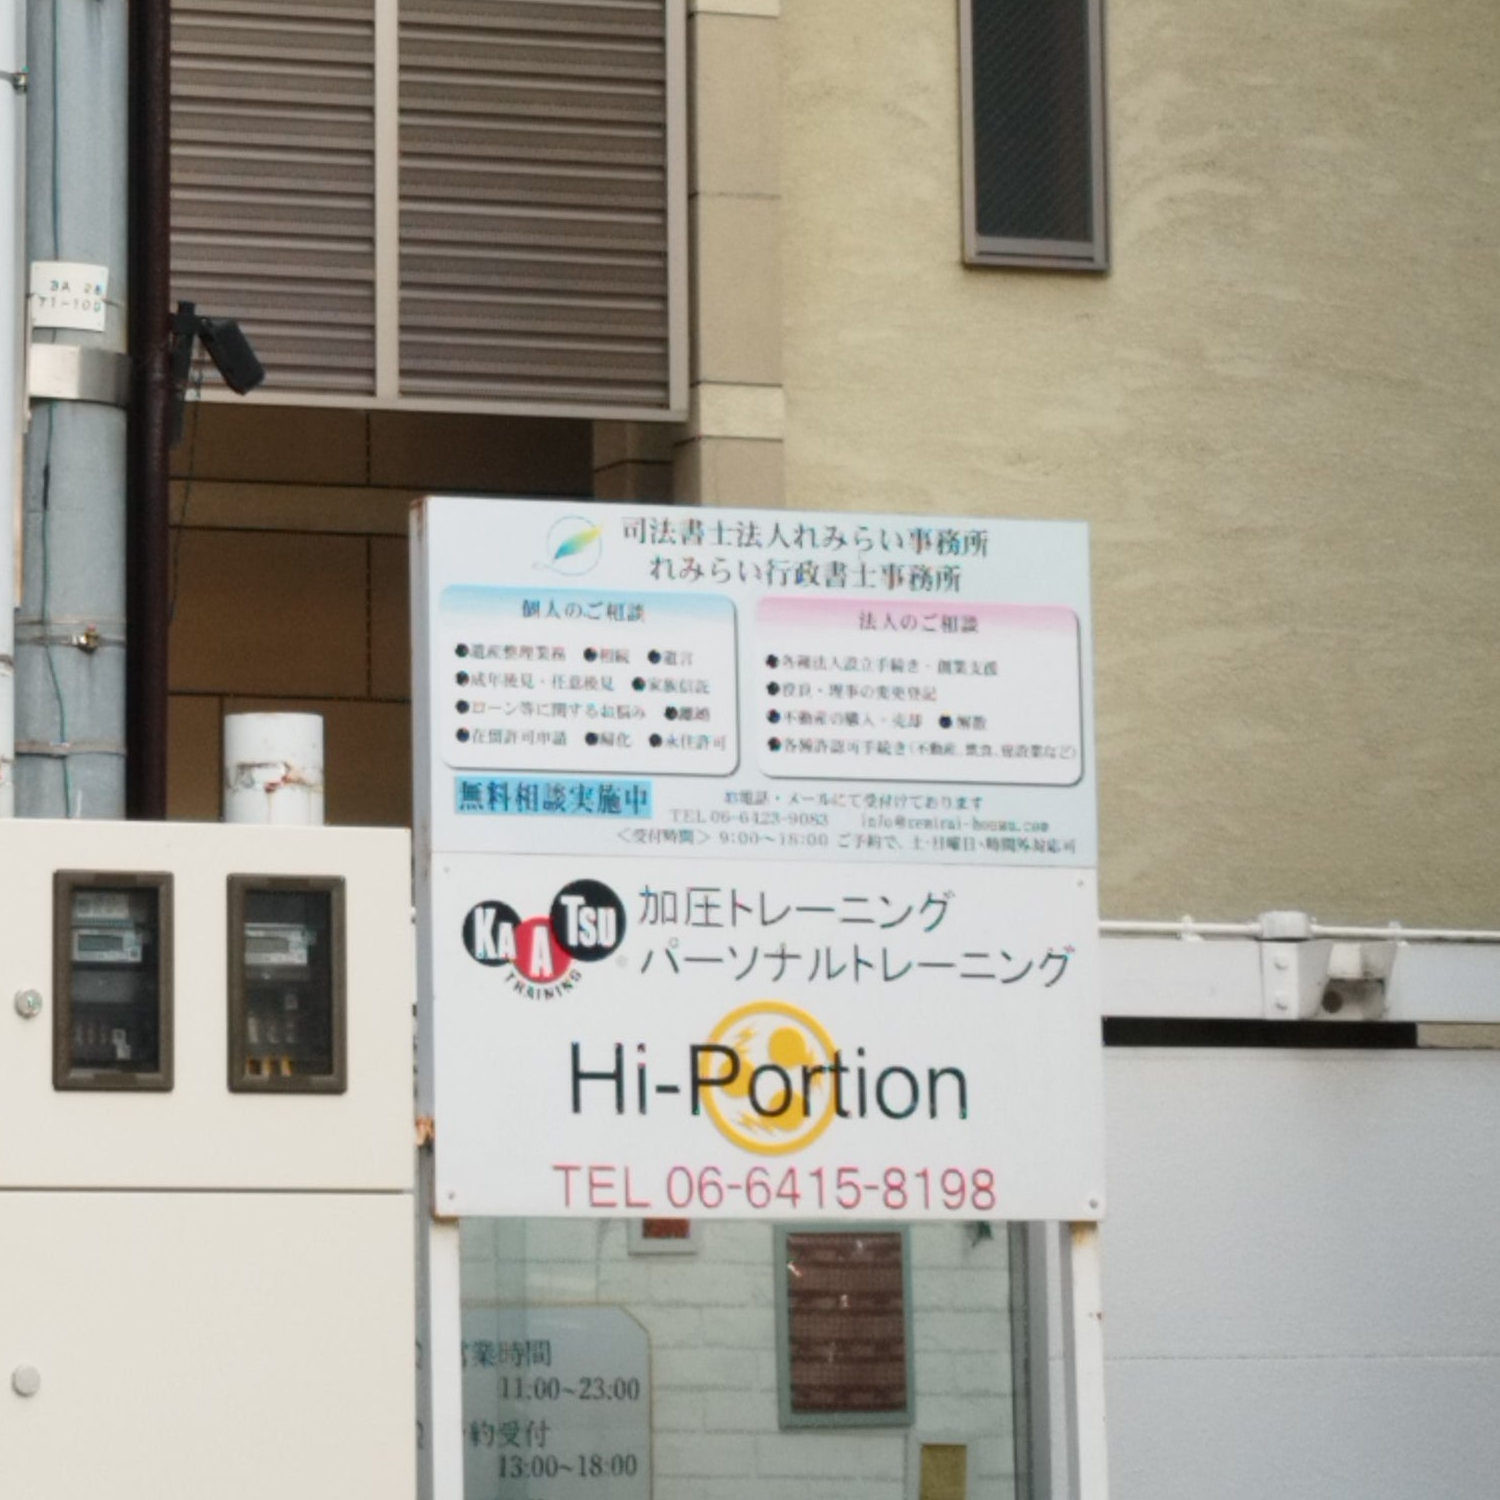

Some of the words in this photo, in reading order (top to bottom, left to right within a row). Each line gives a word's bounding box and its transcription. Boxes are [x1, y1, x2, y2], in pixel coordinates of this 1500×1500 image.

[459, 781, 648, 816] 無料相談実施中
[638, 885, 955, 933] 加圧トレーニング
[639, 937, 1077, 988] パーソナルトレーニング
[570, 1041, 968, 1120] Hi-Portion
[552, 1165, 650, 1209] TEL
[665, 1164, 996, 1211] 06-6415-8198
[463, 1420, 550, 1448] 約受付
